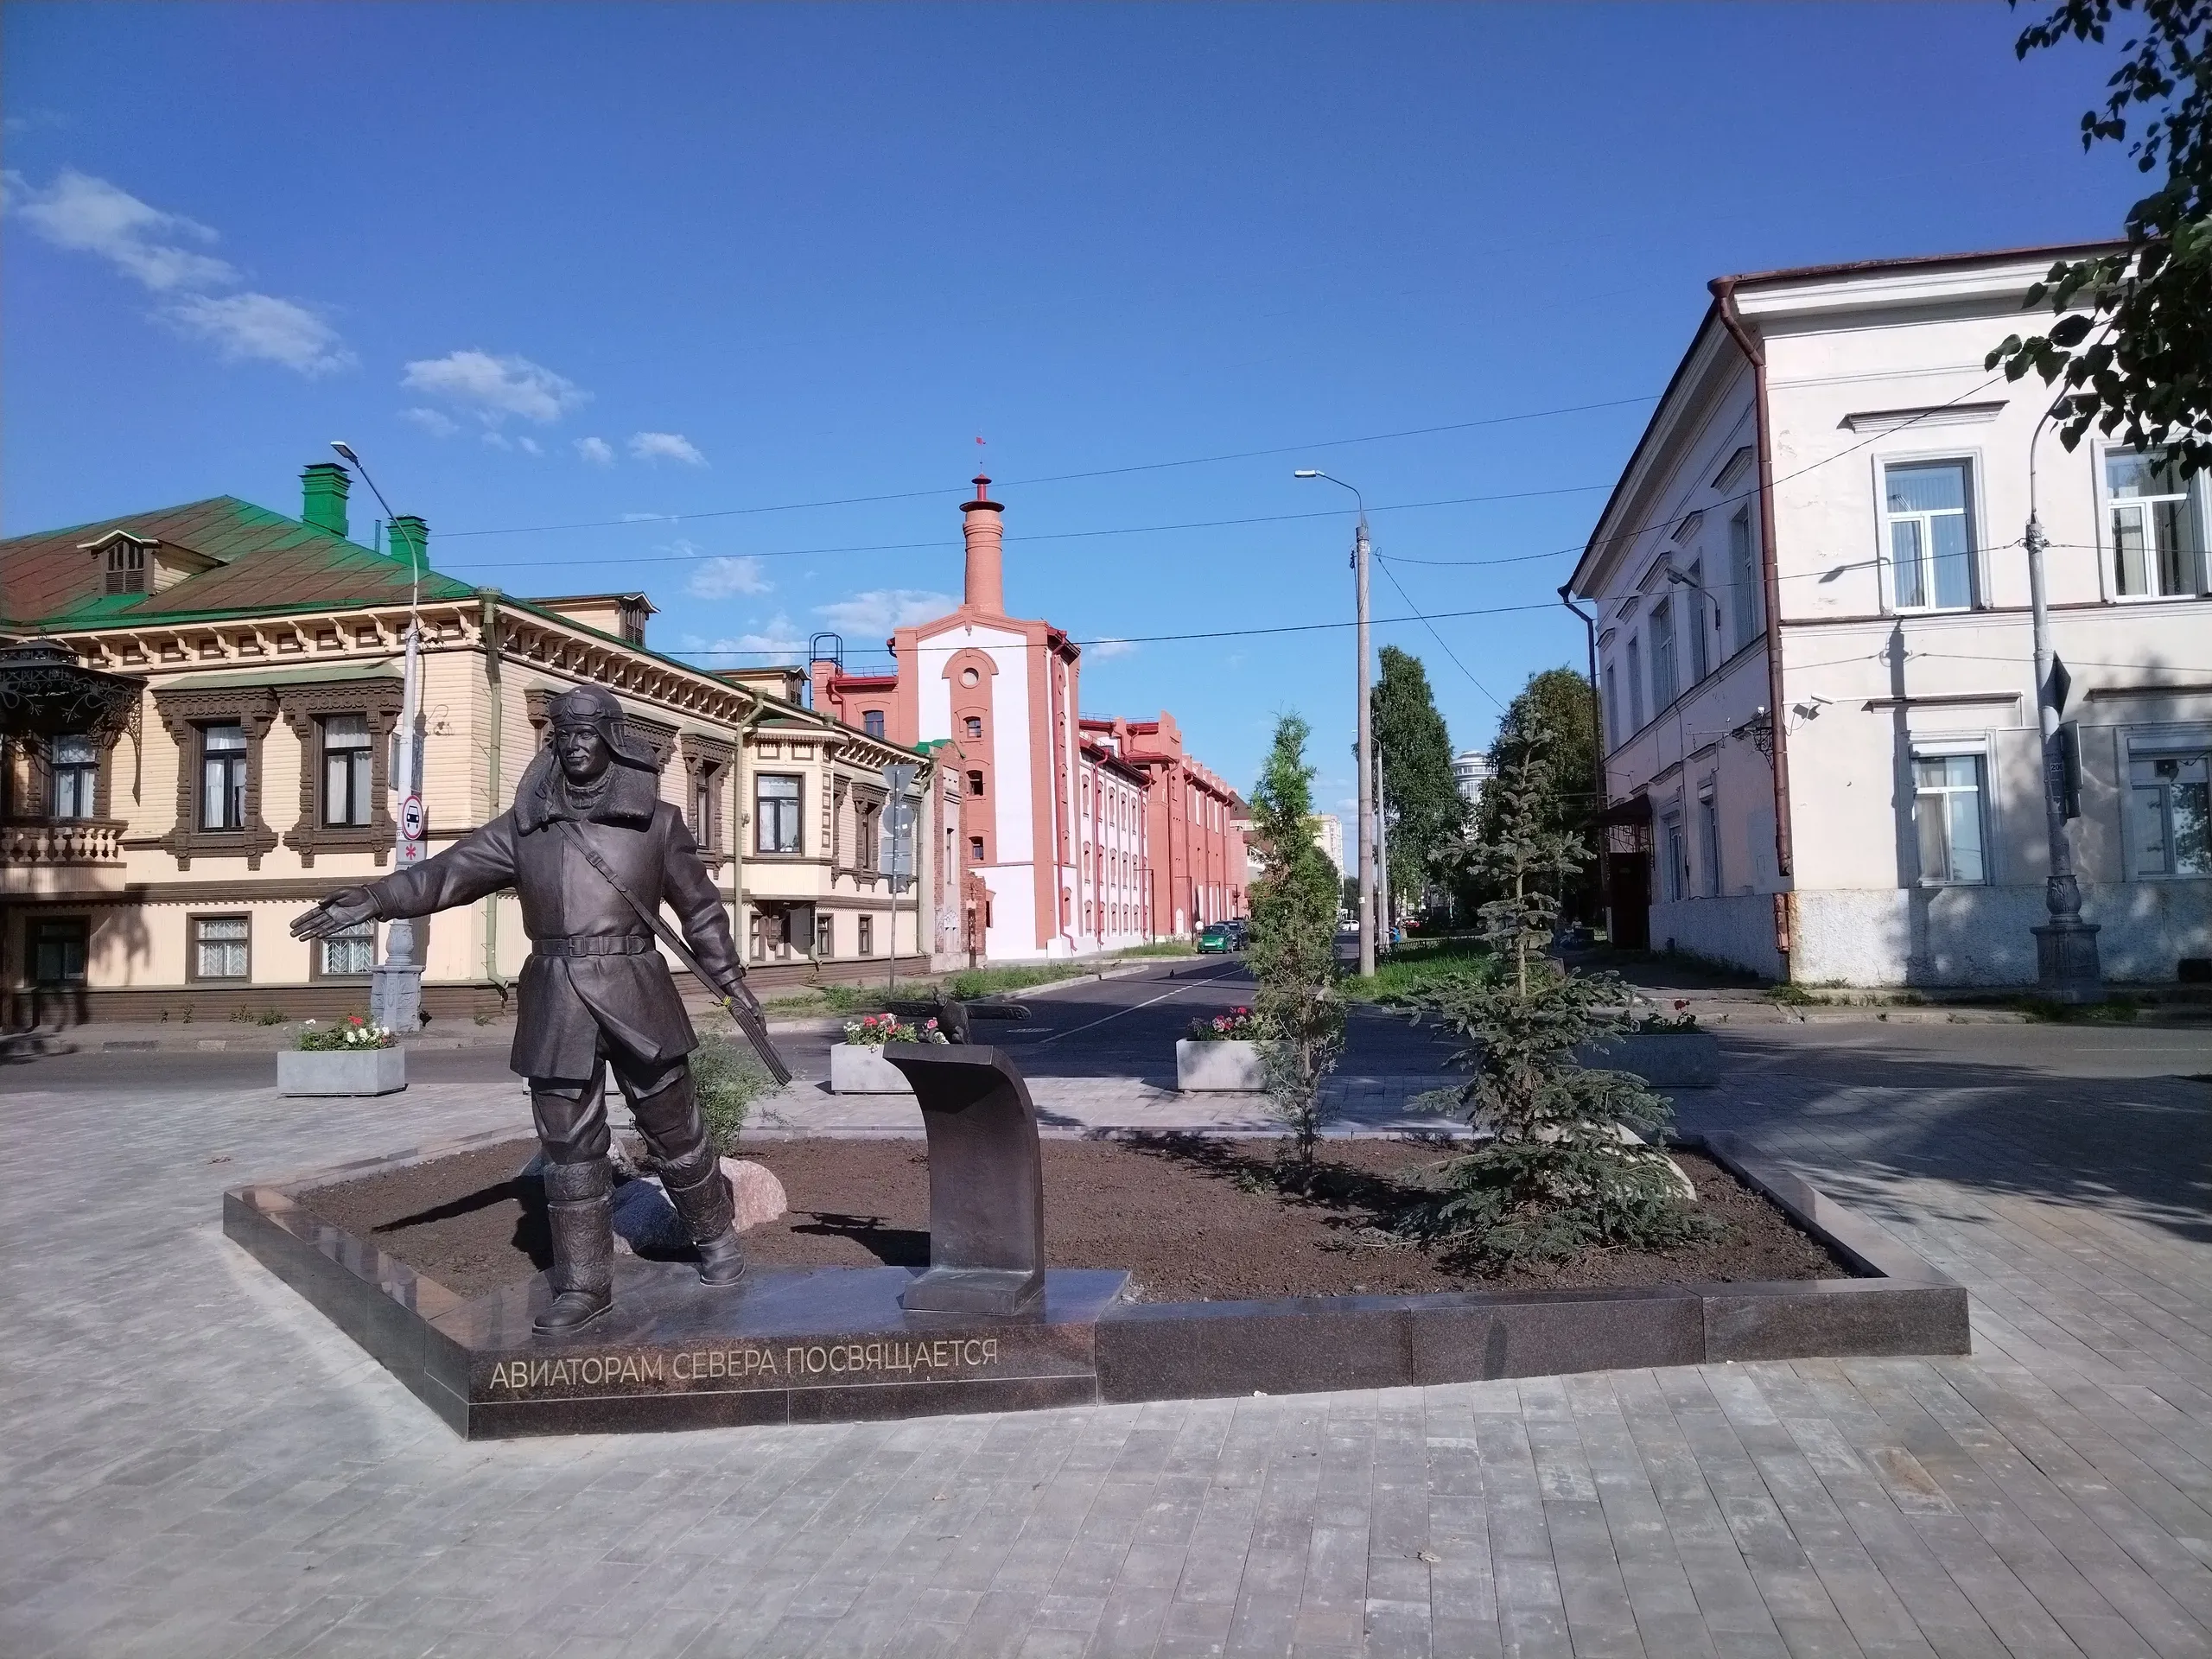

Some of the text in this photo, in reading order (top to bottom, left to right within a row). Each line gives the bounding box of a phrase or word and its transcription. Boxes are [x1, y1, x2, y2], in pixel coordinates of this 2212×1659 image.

[489, 1338, 998, 1389] АВИАТОРАМ СЕВЕРА ПОСВЯЩАЕТСЯ
